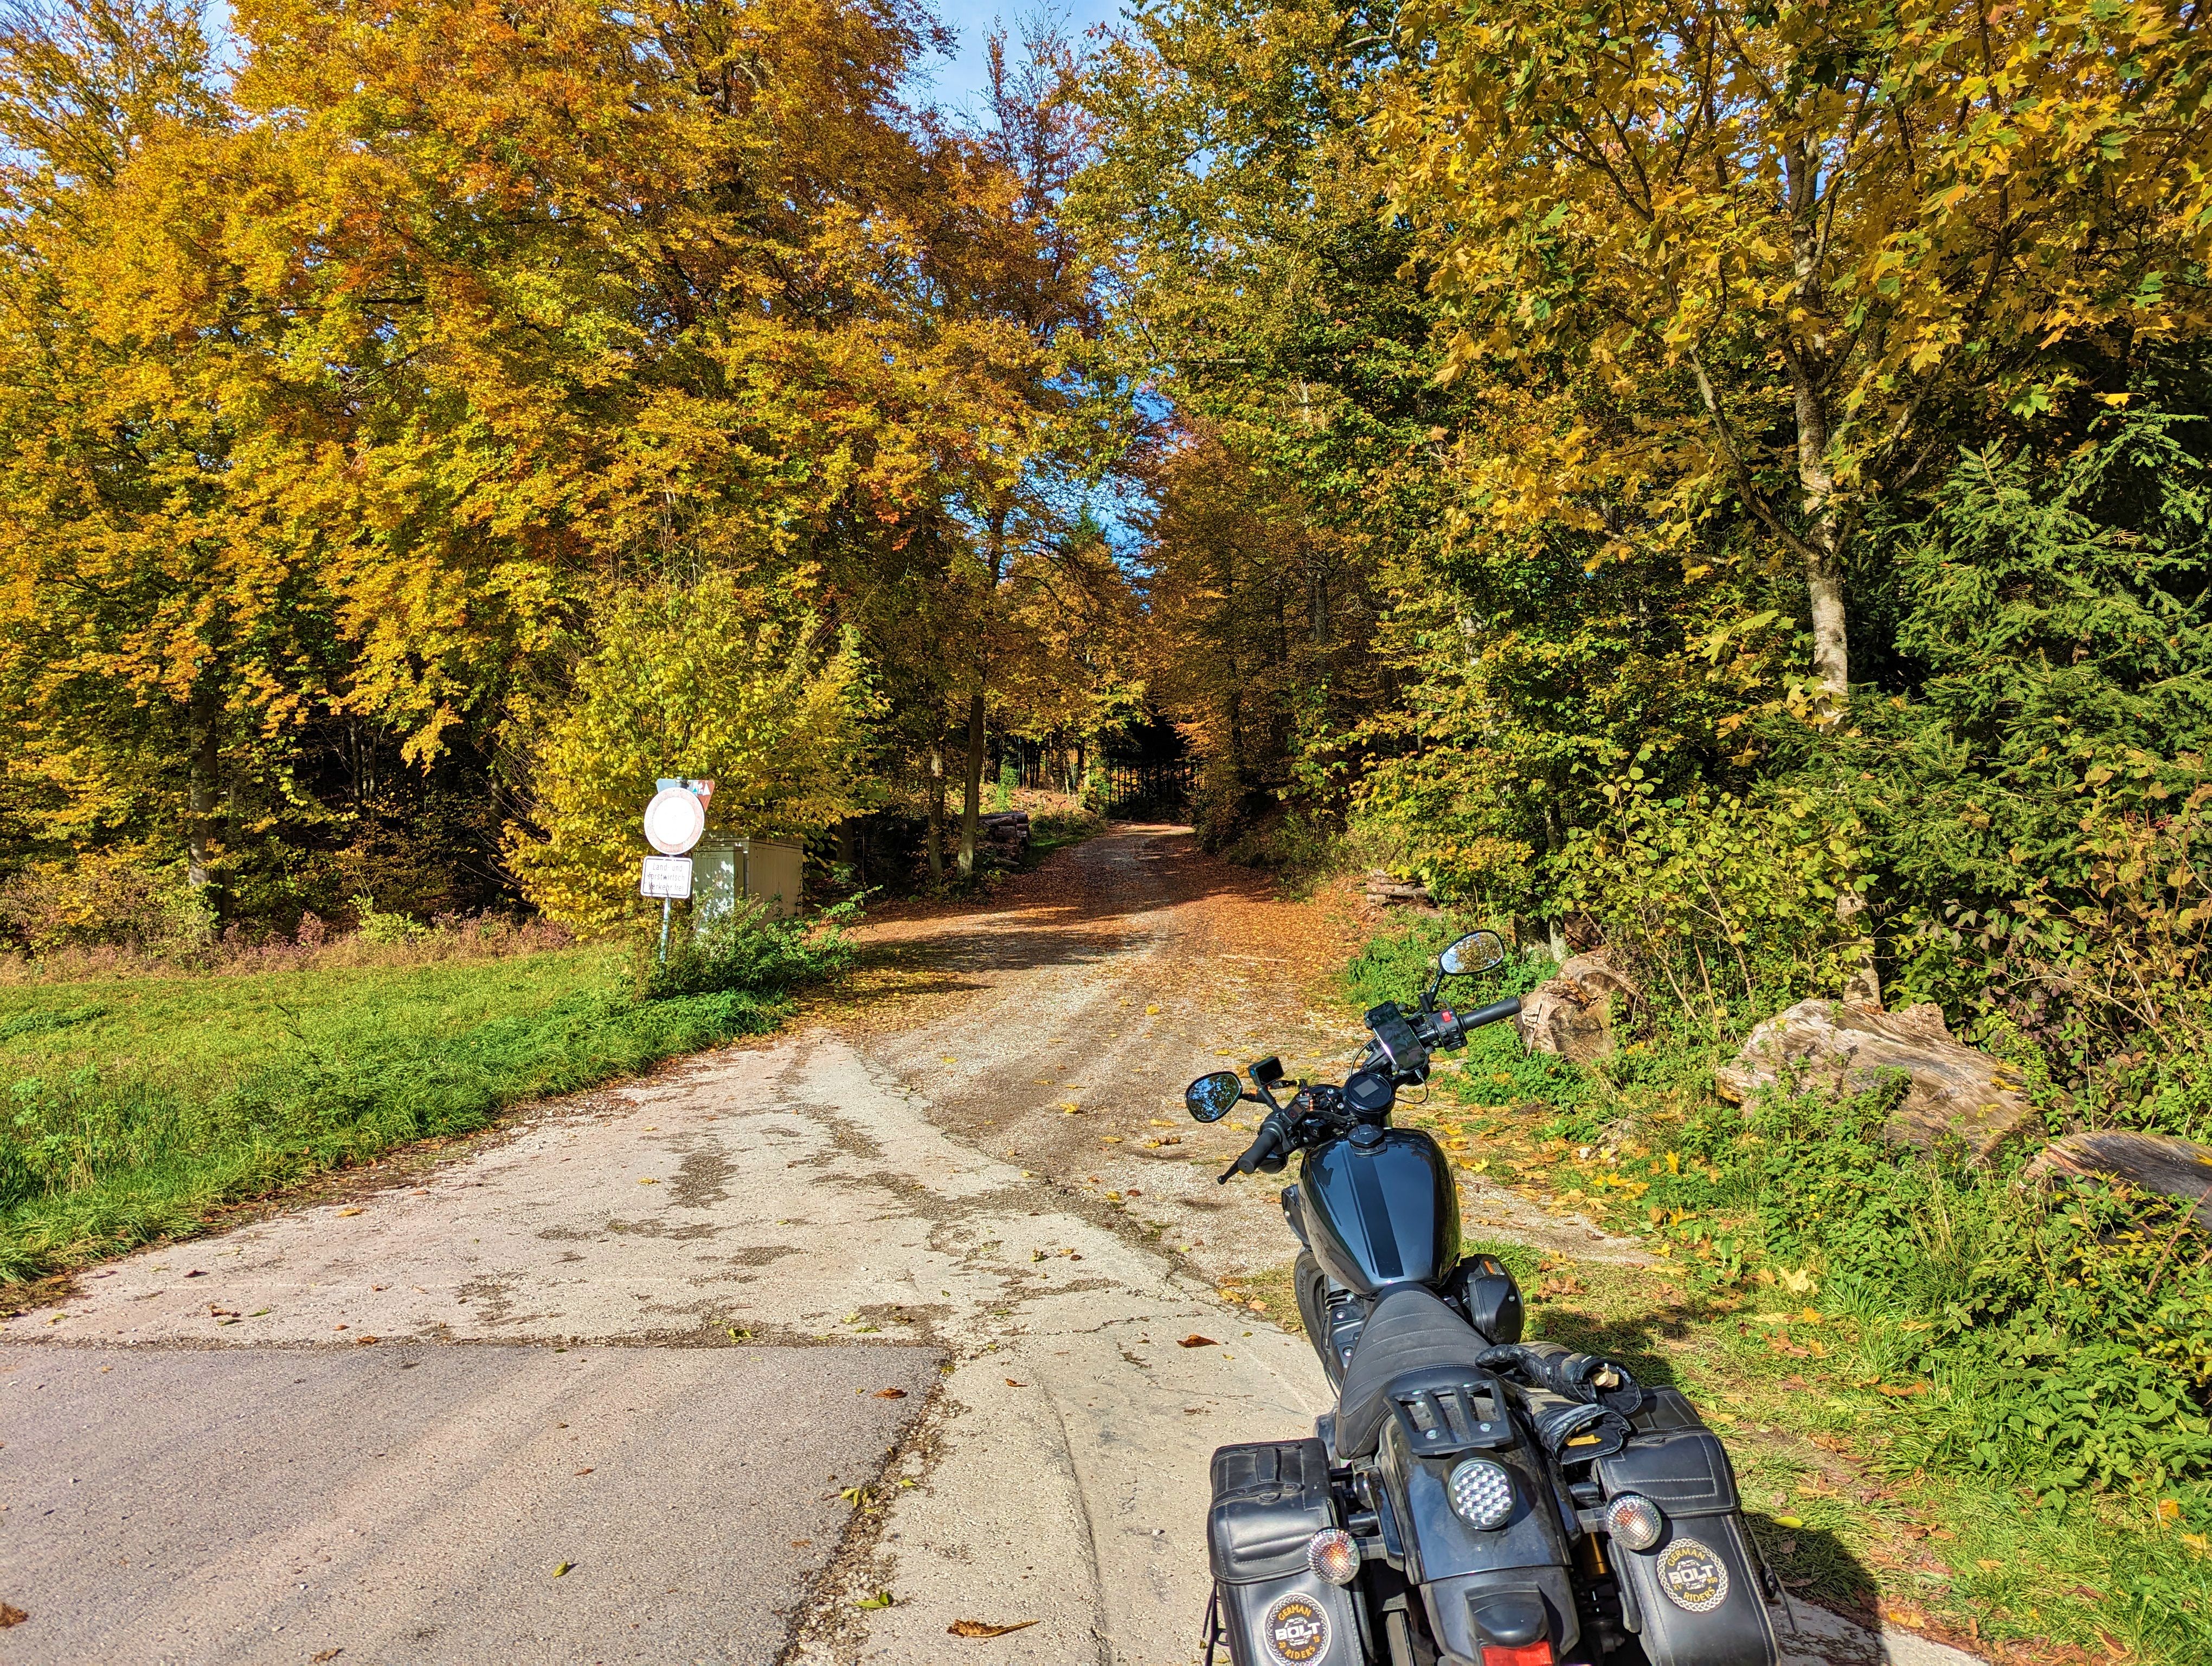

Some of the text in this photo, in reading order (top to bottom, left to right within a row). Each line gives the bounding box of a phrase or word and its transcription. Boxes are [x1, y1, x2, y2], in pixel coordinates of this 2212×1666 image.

[674, 883, 684, 892] frei
[1667, 1547, 1706, 1567] GERMAN
[1668, 1565, 1713, 1585] BOLT
[1683, 1586, 1715, 1602] RIDERS
[1278, 1604, 1313, 1621] GERMAN
[1275, 1622, 1321, 1641] BOLT
[1284, 1645, 1316, 1659] RIDERS
